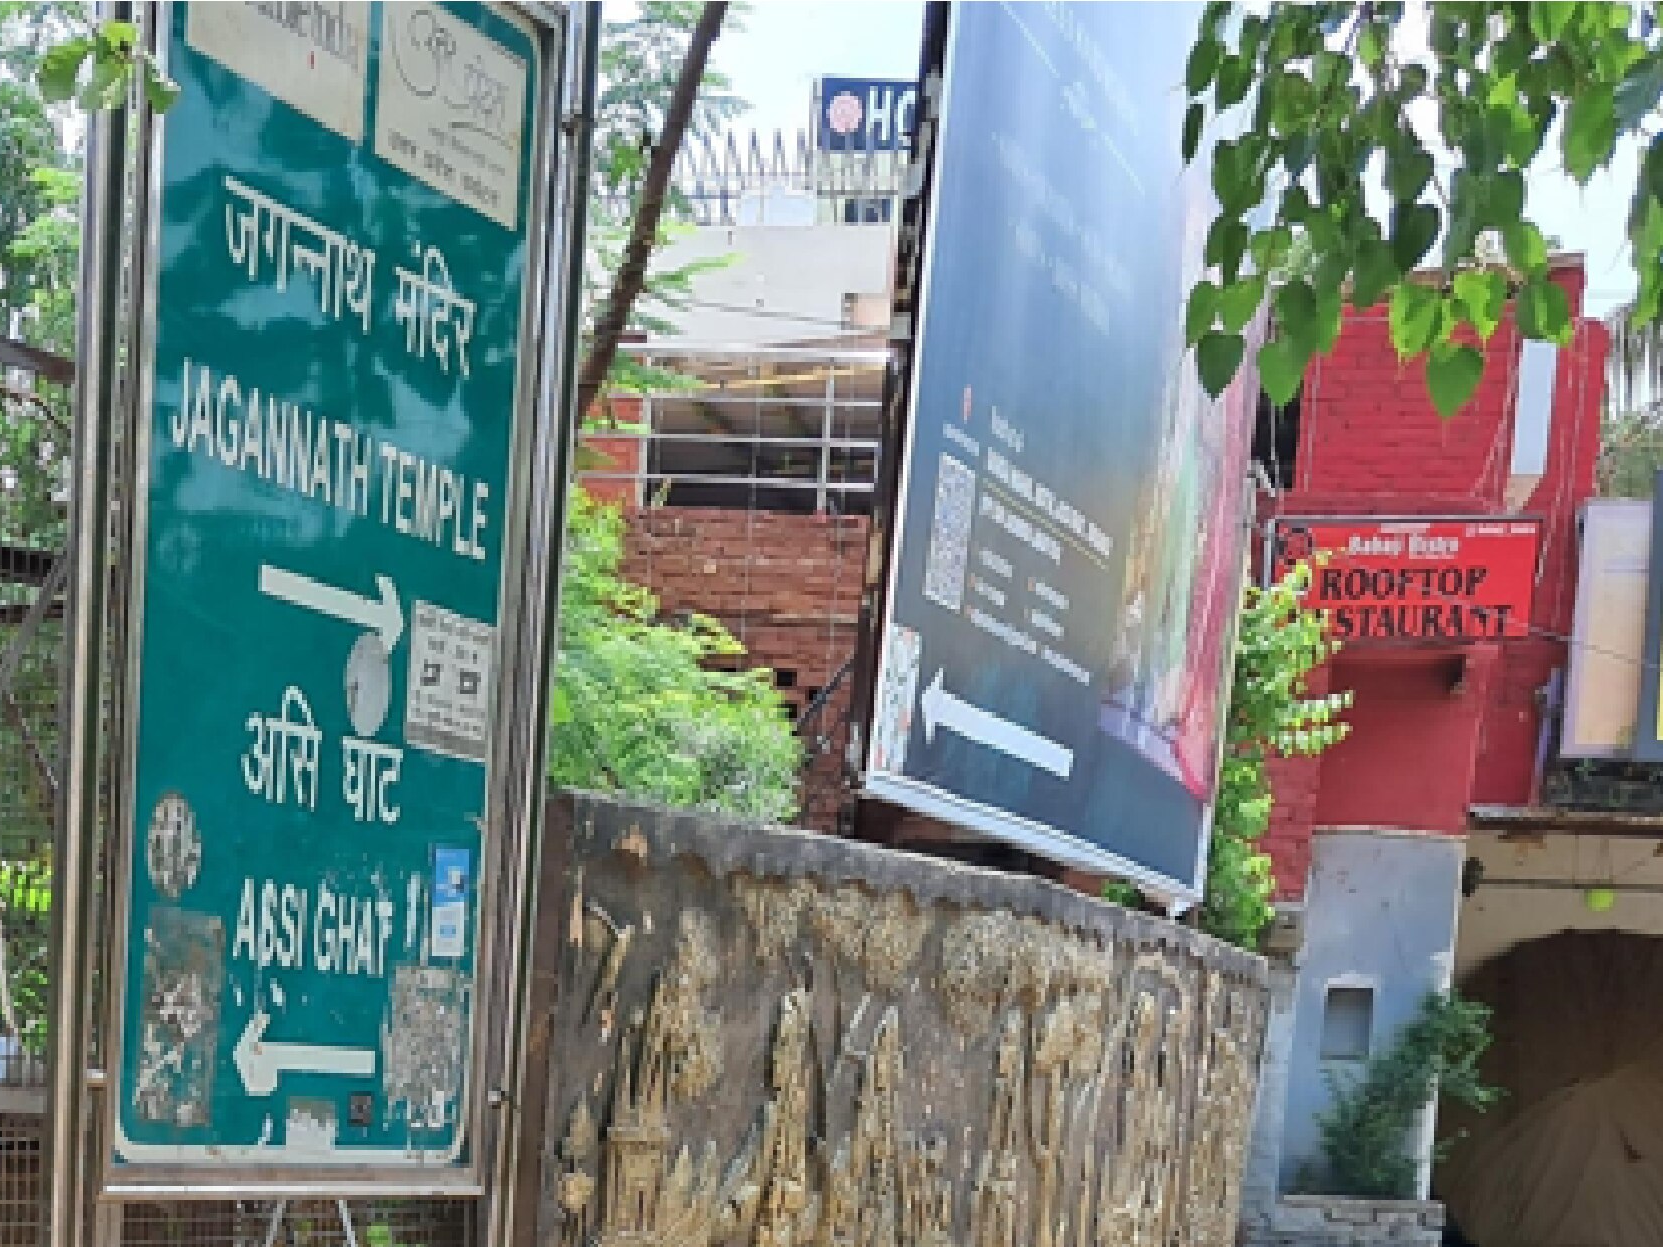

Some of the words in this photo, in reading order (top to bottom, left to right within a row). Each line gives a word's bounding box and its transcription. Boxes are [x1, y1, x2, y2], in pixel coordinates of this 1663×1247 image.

[224, 174, 376, 335] जगन्नाथ
[393, 238, 478, 380] मंदिर
[171, 356, 373, 517] JAGANNATH
[379, 441, 490, 560] TEMPLE
[1314, 603, 1514, 639] STAURANT
[1320, 567, 1488, 602] ROOFTOP
[240, 686, 323, 812] असि
[342, 736, 404, 824] घाट
[313, 887, 394, 978] GHAT
